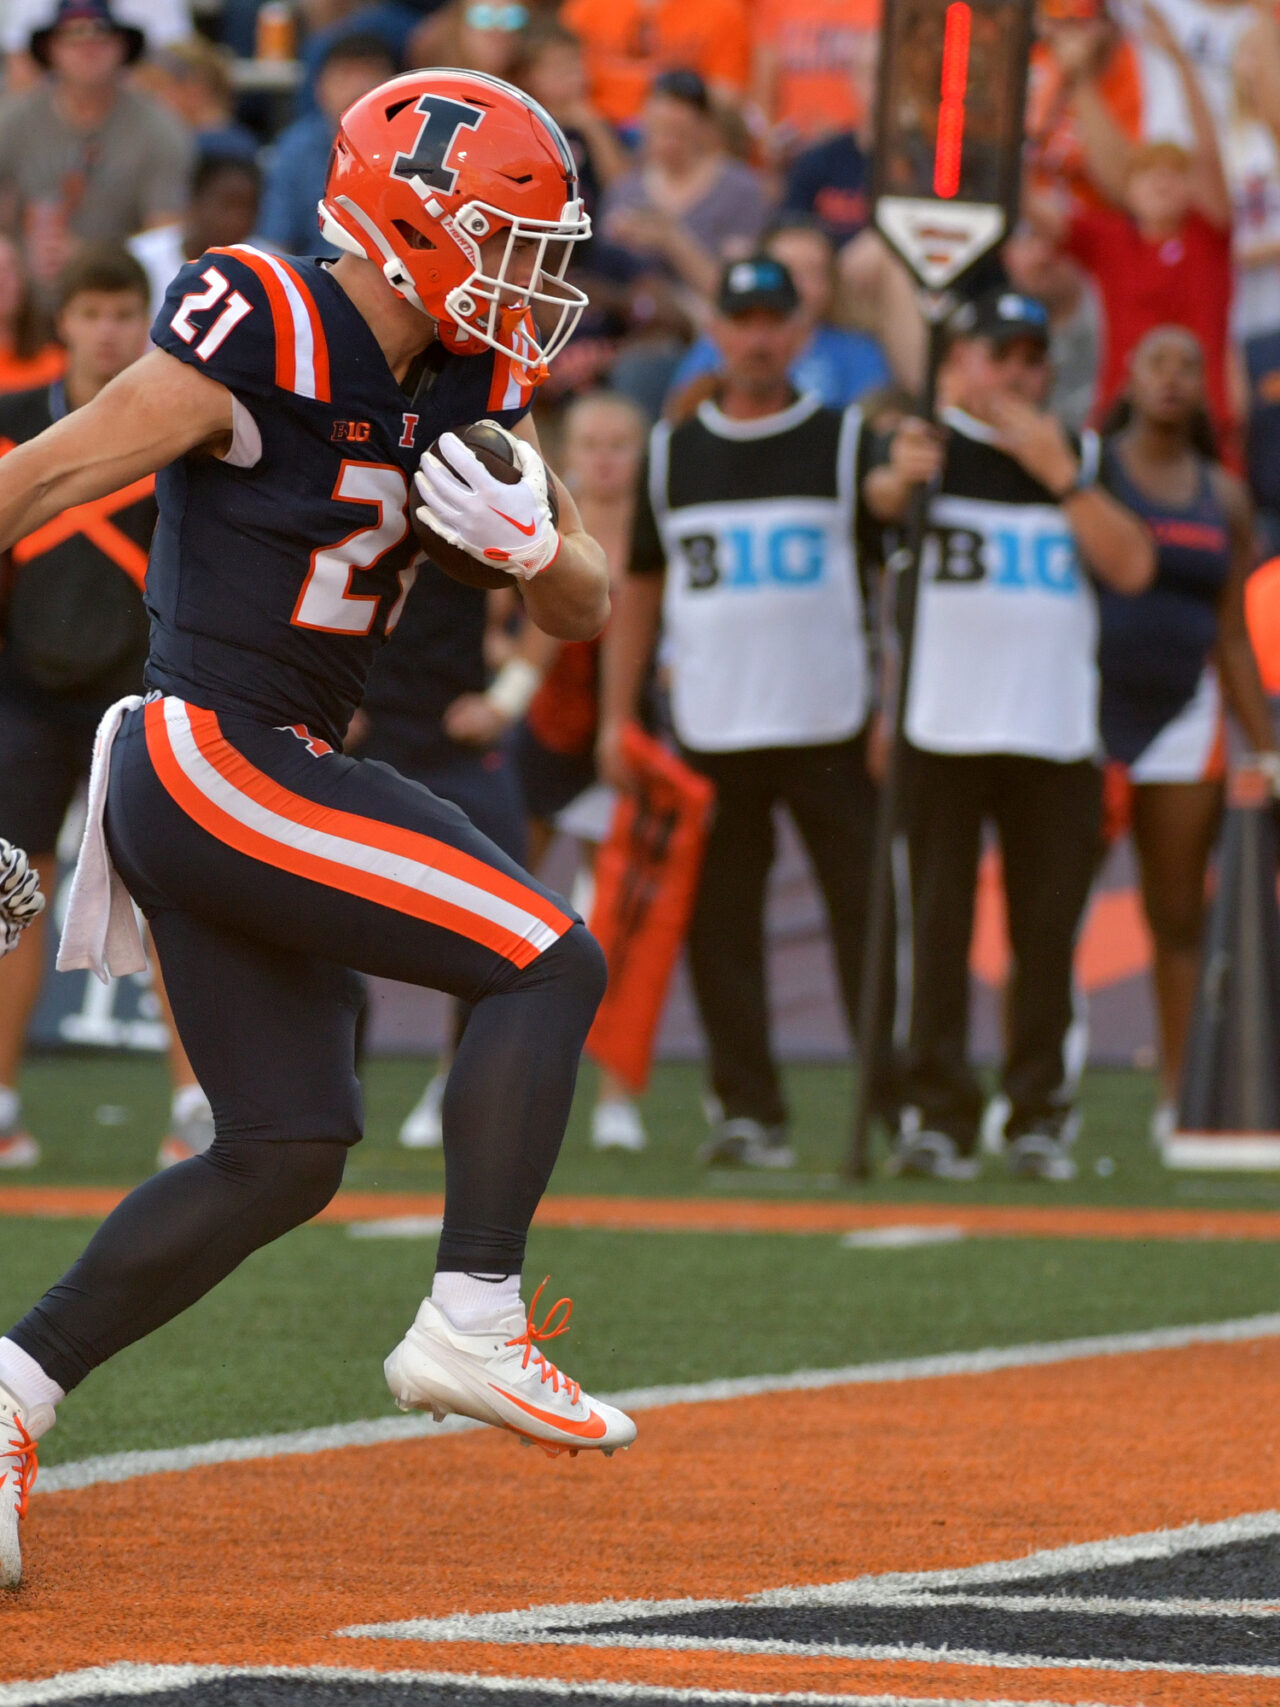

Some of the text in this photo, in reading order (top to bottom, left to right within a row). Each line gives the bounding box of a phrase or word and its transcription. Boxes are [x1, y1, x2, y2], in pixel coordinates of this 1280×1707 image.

[389, 92, 487, 197] I
[169, 265, 254, 362] 21
[398, 413, 420, 448] I
